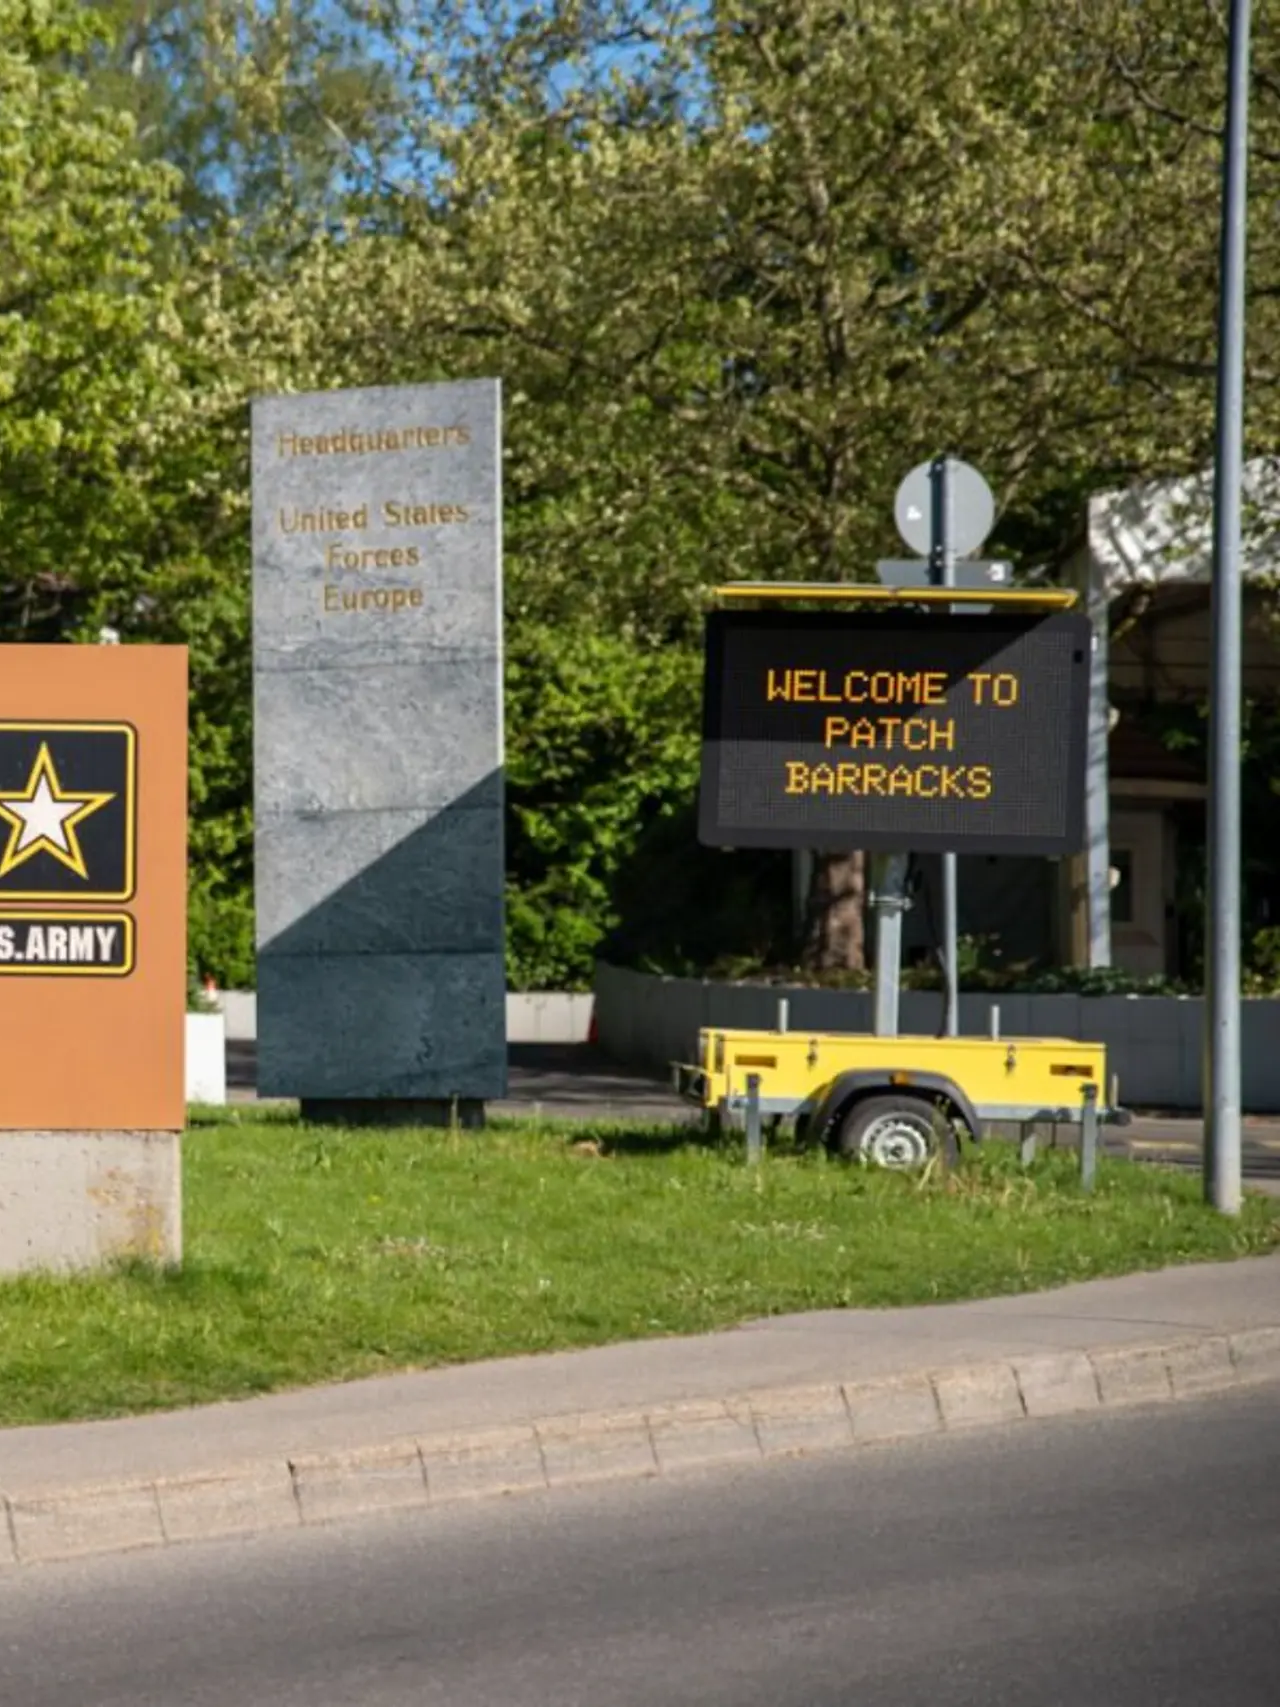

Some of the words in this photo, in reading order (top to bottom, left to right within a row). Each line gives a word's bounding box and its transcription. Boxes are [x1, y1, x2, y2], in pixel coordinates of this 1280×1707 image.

[278, 423, 472, 458] Headquarters
[279, 503, 369, 535] United
[382, 500, 470, 528] States
[325, 541, 421, 572] Forces
[323, 583, 425, 614] Europe
[766, 669, 948, 705] WELCOME
[967, 672, 1019, 707] TO
[824, 716, 956, 752] PATCH
[784, 761, 993, 799] BARRACKS
